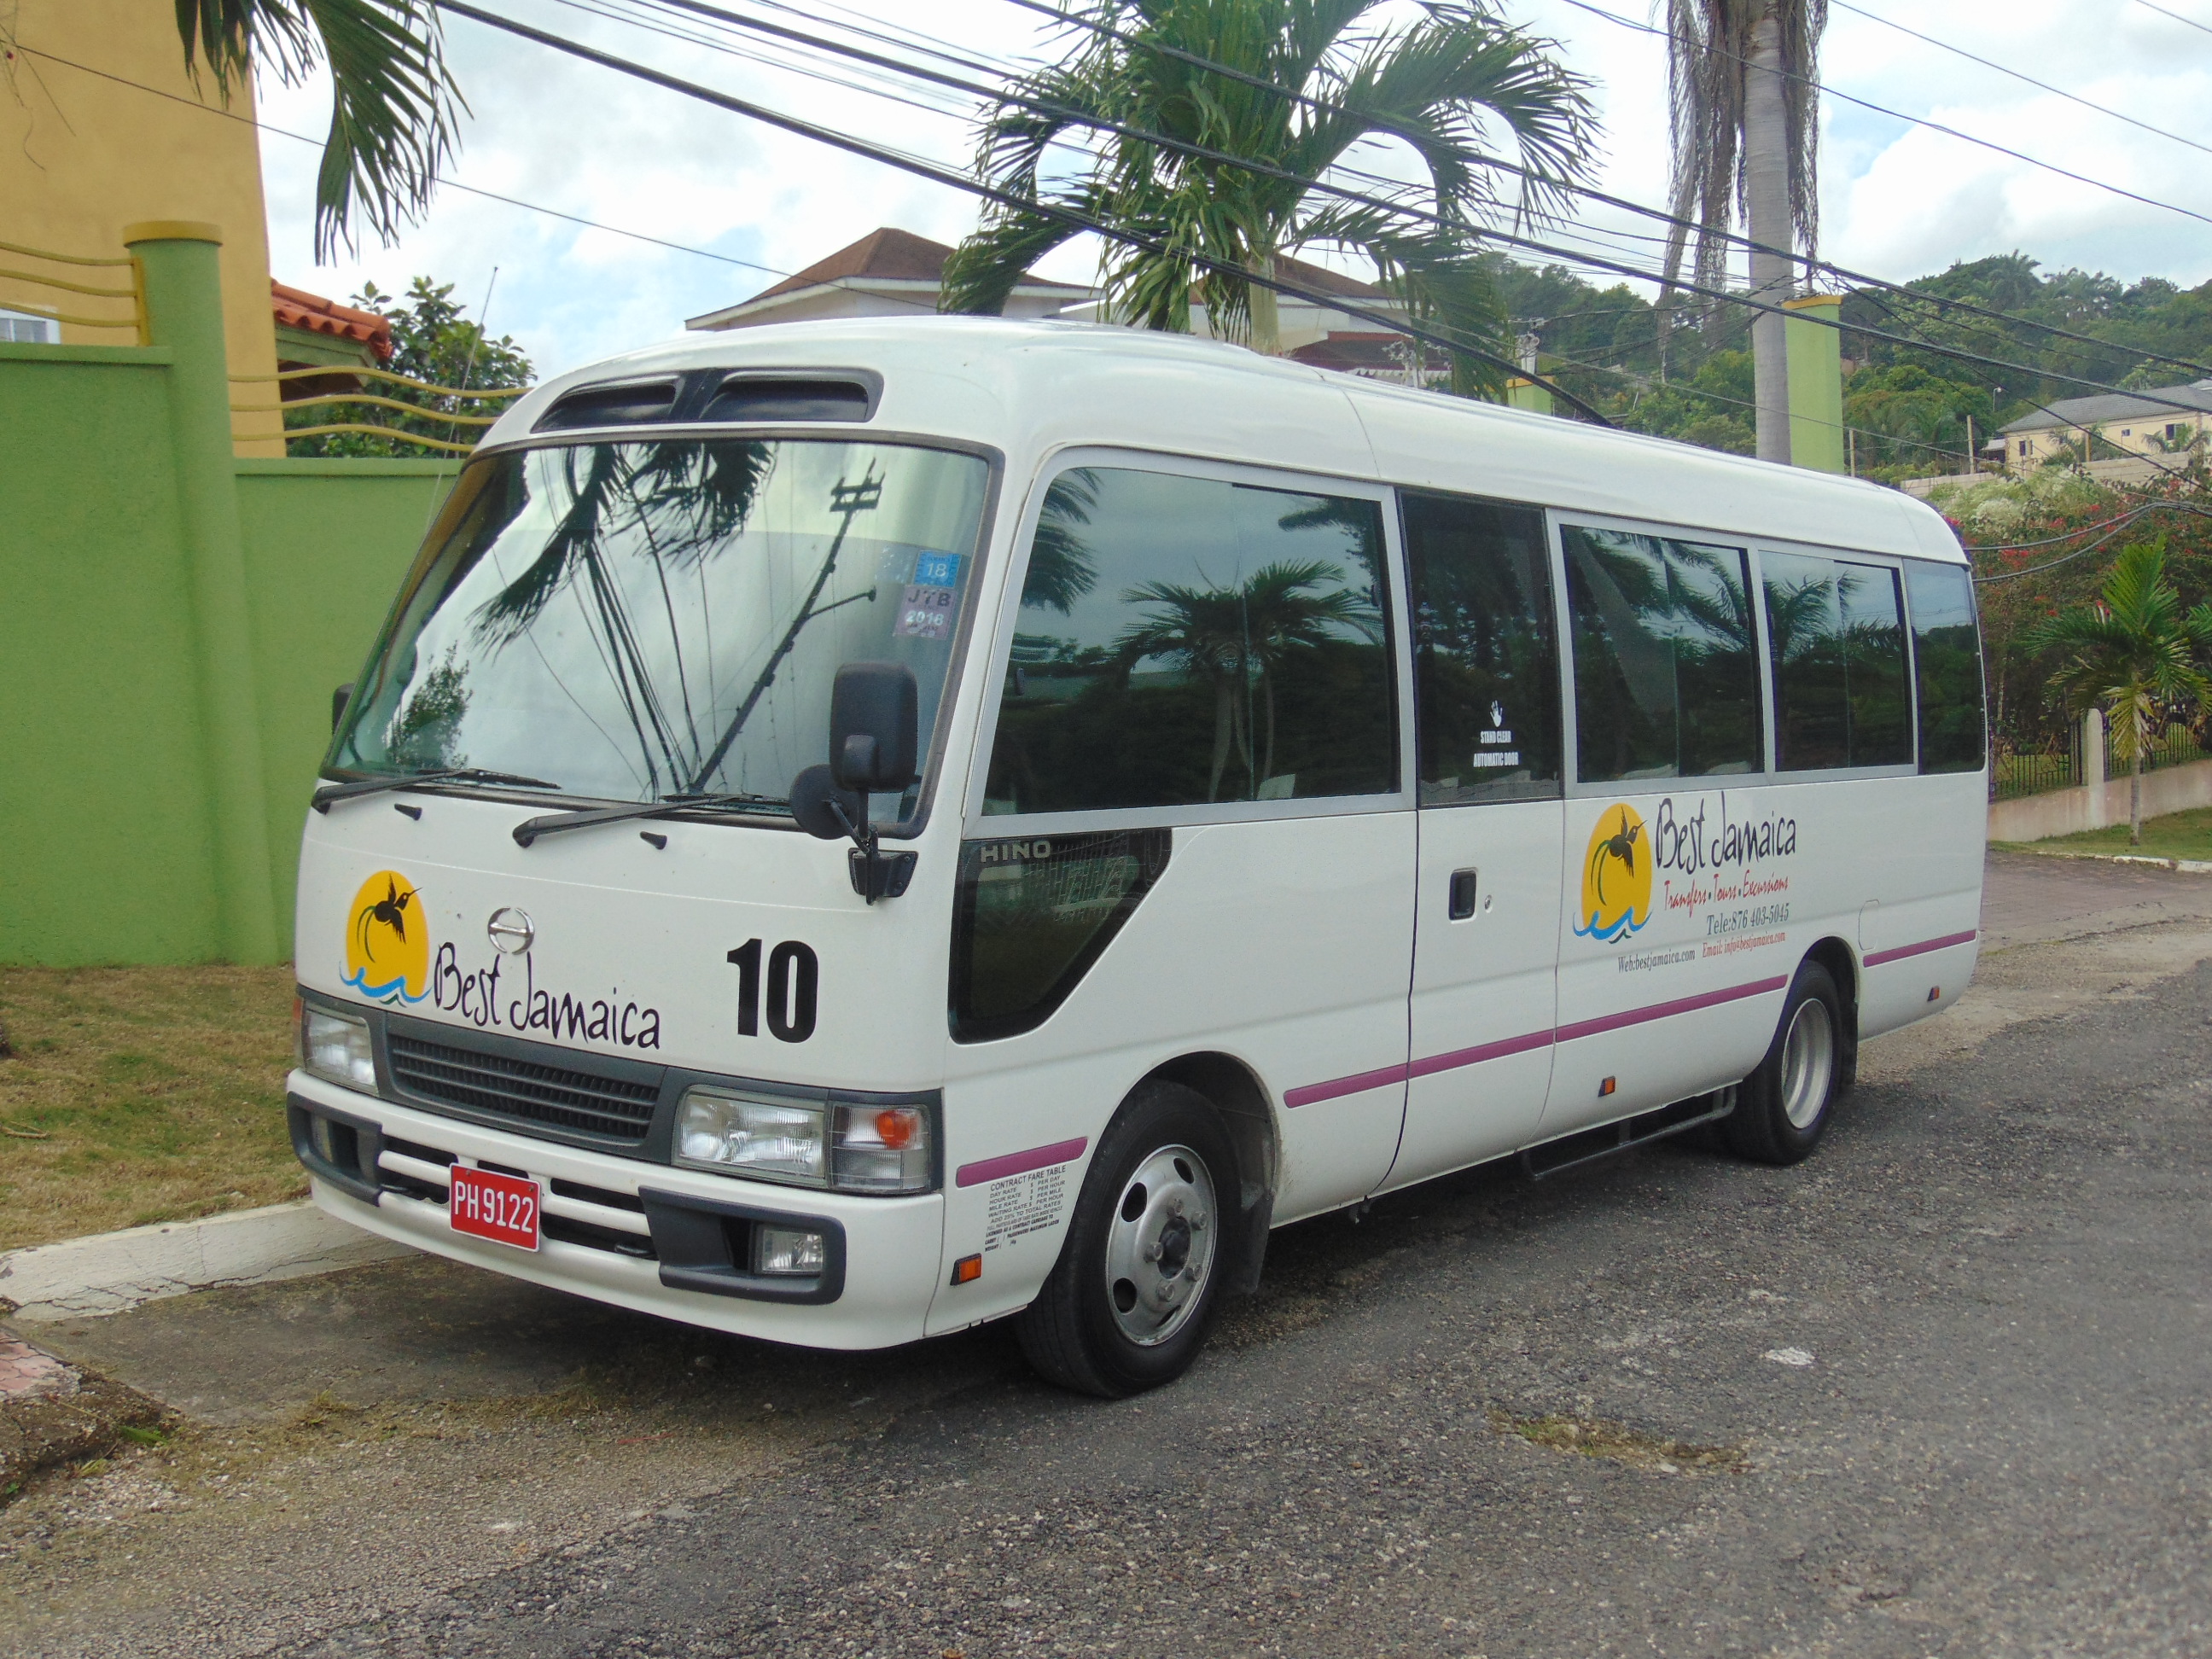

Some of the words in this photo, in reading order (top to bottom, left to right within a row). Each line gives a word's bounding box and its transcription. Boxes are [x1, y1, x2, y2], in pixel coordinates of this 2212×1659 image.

[927, 562, 946, 577] 18
[908, 589, 951, 607] JTB
[906, 609, 944, 626] 2018
[1481, 731, 1496, 743] STAND
[1496, 731, 1511, 743] CLEAR
[1473, 752, 1504, 767] AUTOMATIC
[1504, 752, 1519, 765] DOOR
[1655, 797, 1706, 875] Best
[1711, 790, 1796, 867] Jamaica
[981, 840, 1051, 863] HINO
[1750, 903, 1789, 927] 403-5045
[434, 942, 500, 1027] Best
[510, 952, 661, 1050] Jamaica
[726, 937, 818, 1044] 10
[991, 1176, 1027, 1191] CONTRACT
[1028, 1171, 1045, 1182] FARE
[1046, 1165, 1066, 1176] TABLE
